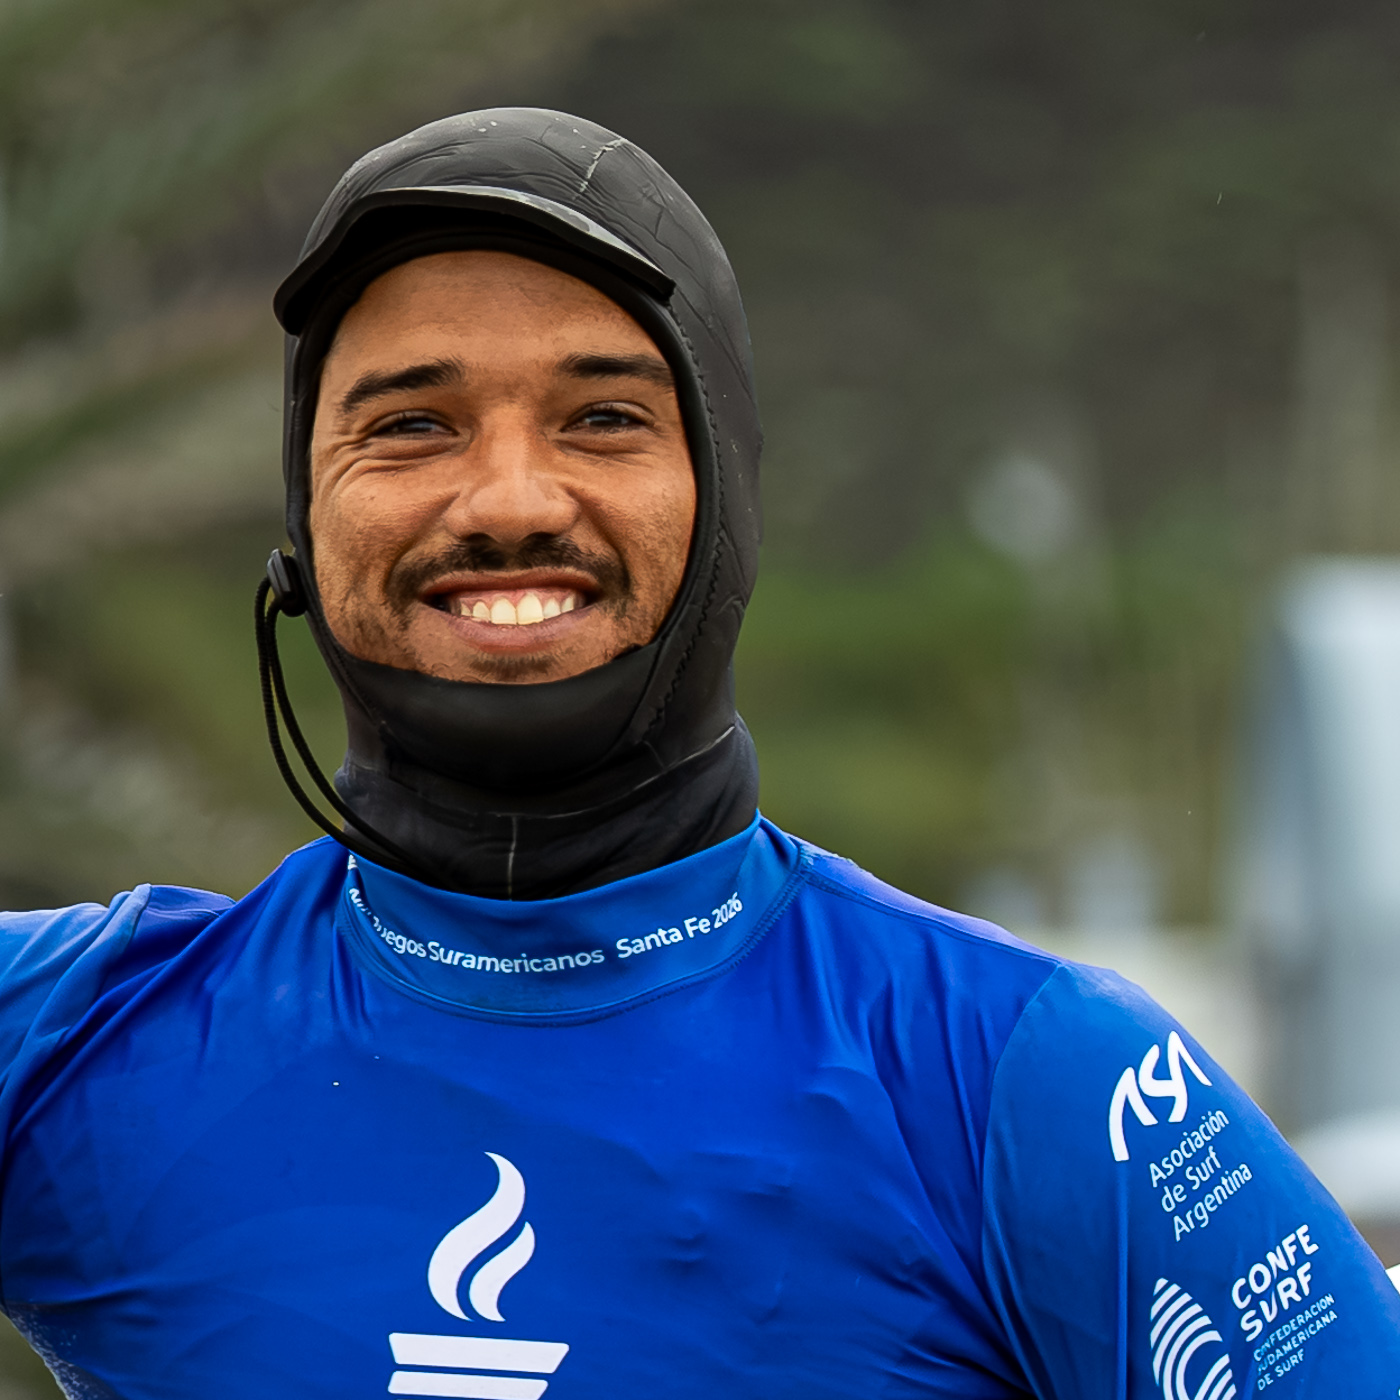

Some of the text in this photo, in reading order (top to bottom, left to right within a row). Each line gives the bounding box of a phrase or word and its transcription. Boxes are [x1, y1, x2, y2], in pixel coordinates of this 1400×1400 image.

[428, 940, 605, 974] Suramericanos
[616, 927, 683, 958] Santa
[685, 917, 711, 938] Fe
[713, 892, 743, 930] 2026
[1149, 1110, 1229, 1188] Asociación
[1161, 1149, 1221, 1213] de Surf
[1174, 1163, 1253, 1242] Argentina
[1231, 1224, 1319, 1310] CONFE
[1240, 1261, 1313, 1342] SURF
[1257, 1348, 1305, 1391] DE SURF
